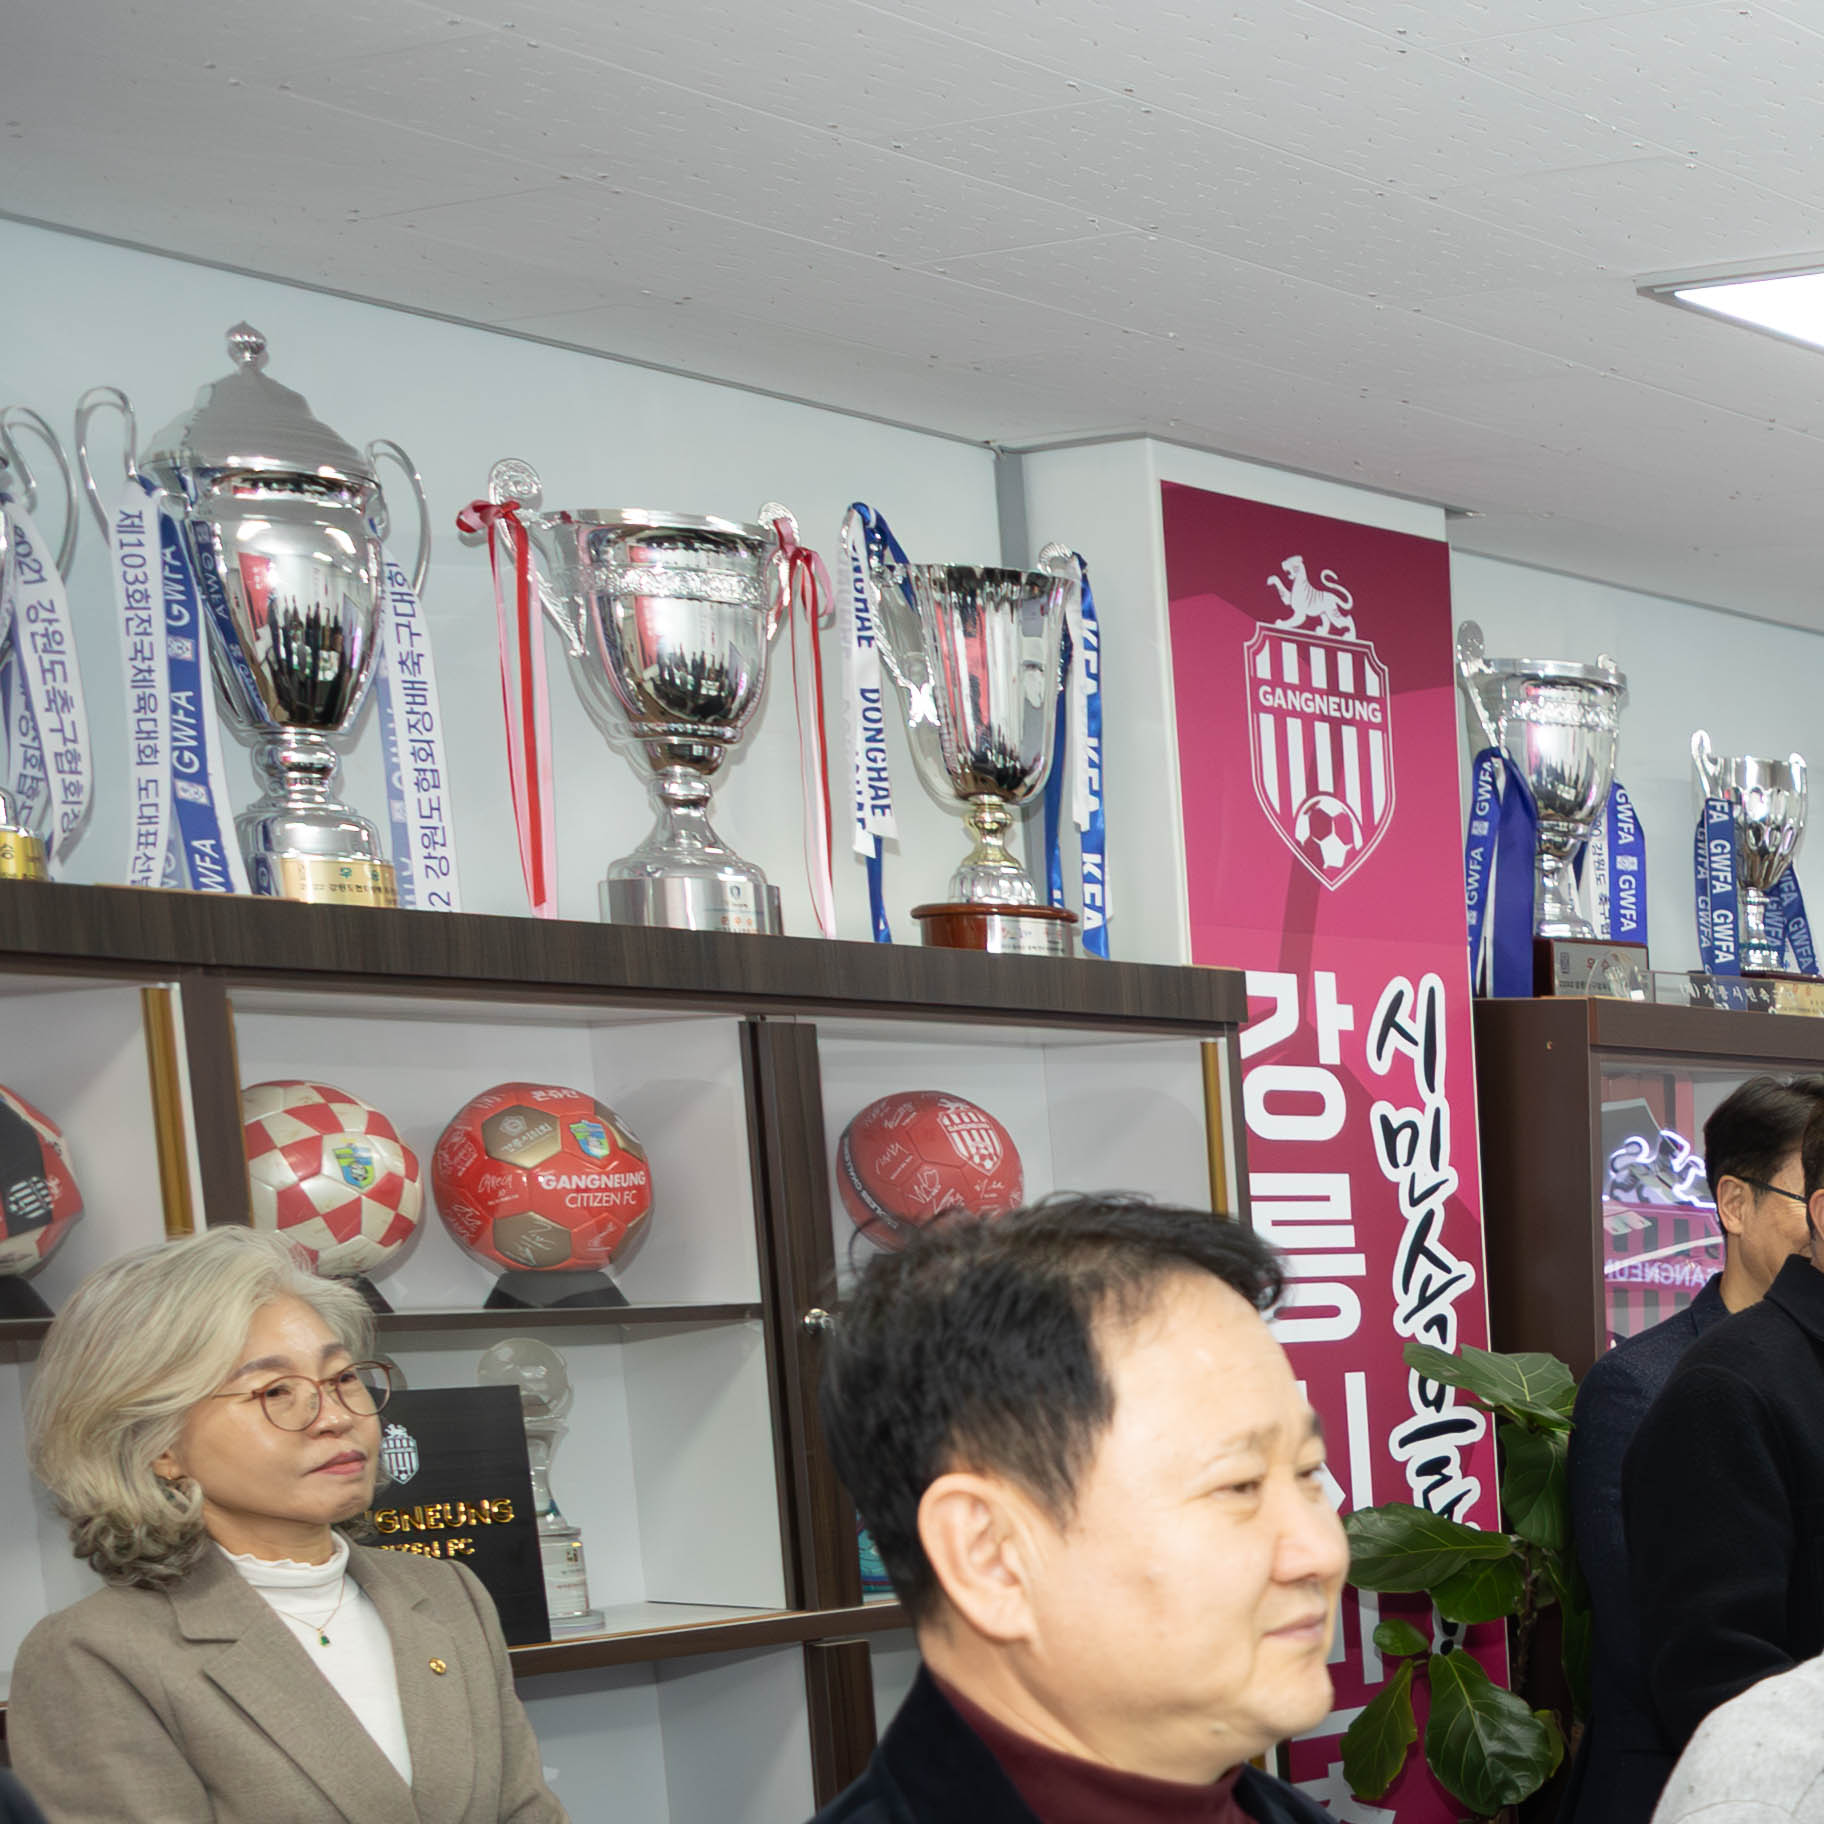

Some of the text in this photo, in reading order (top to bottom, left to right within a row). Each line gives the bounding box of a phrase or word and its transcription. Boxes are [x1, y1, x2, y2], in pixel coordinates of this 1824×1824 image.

[162, 544, 189, 628] GWFA
[117, 509, 159, 767] 제103회전국체육대회
[170, 690, 199, 774] GWFA
[1258, 684, 1383, 724] GANGNEUNG
[860, 688, 893, 817] DONGHAE
[1466, 761, 1493, 905] GWFA GWFA
[1616, 789, 1637, 932] GWFA GWFA
[429, 890, 452, 913] 2
[1708, 801, 1736, 964] FA GWFA GWFA
[1788, 916, 1813, 971] GWFA
[541, 1173, 647, 1191] GANGNEUNG
[565, 1190, 637, 1209] CITIZEN FC
[374, 1497, 516, 1535] GNEUNG
